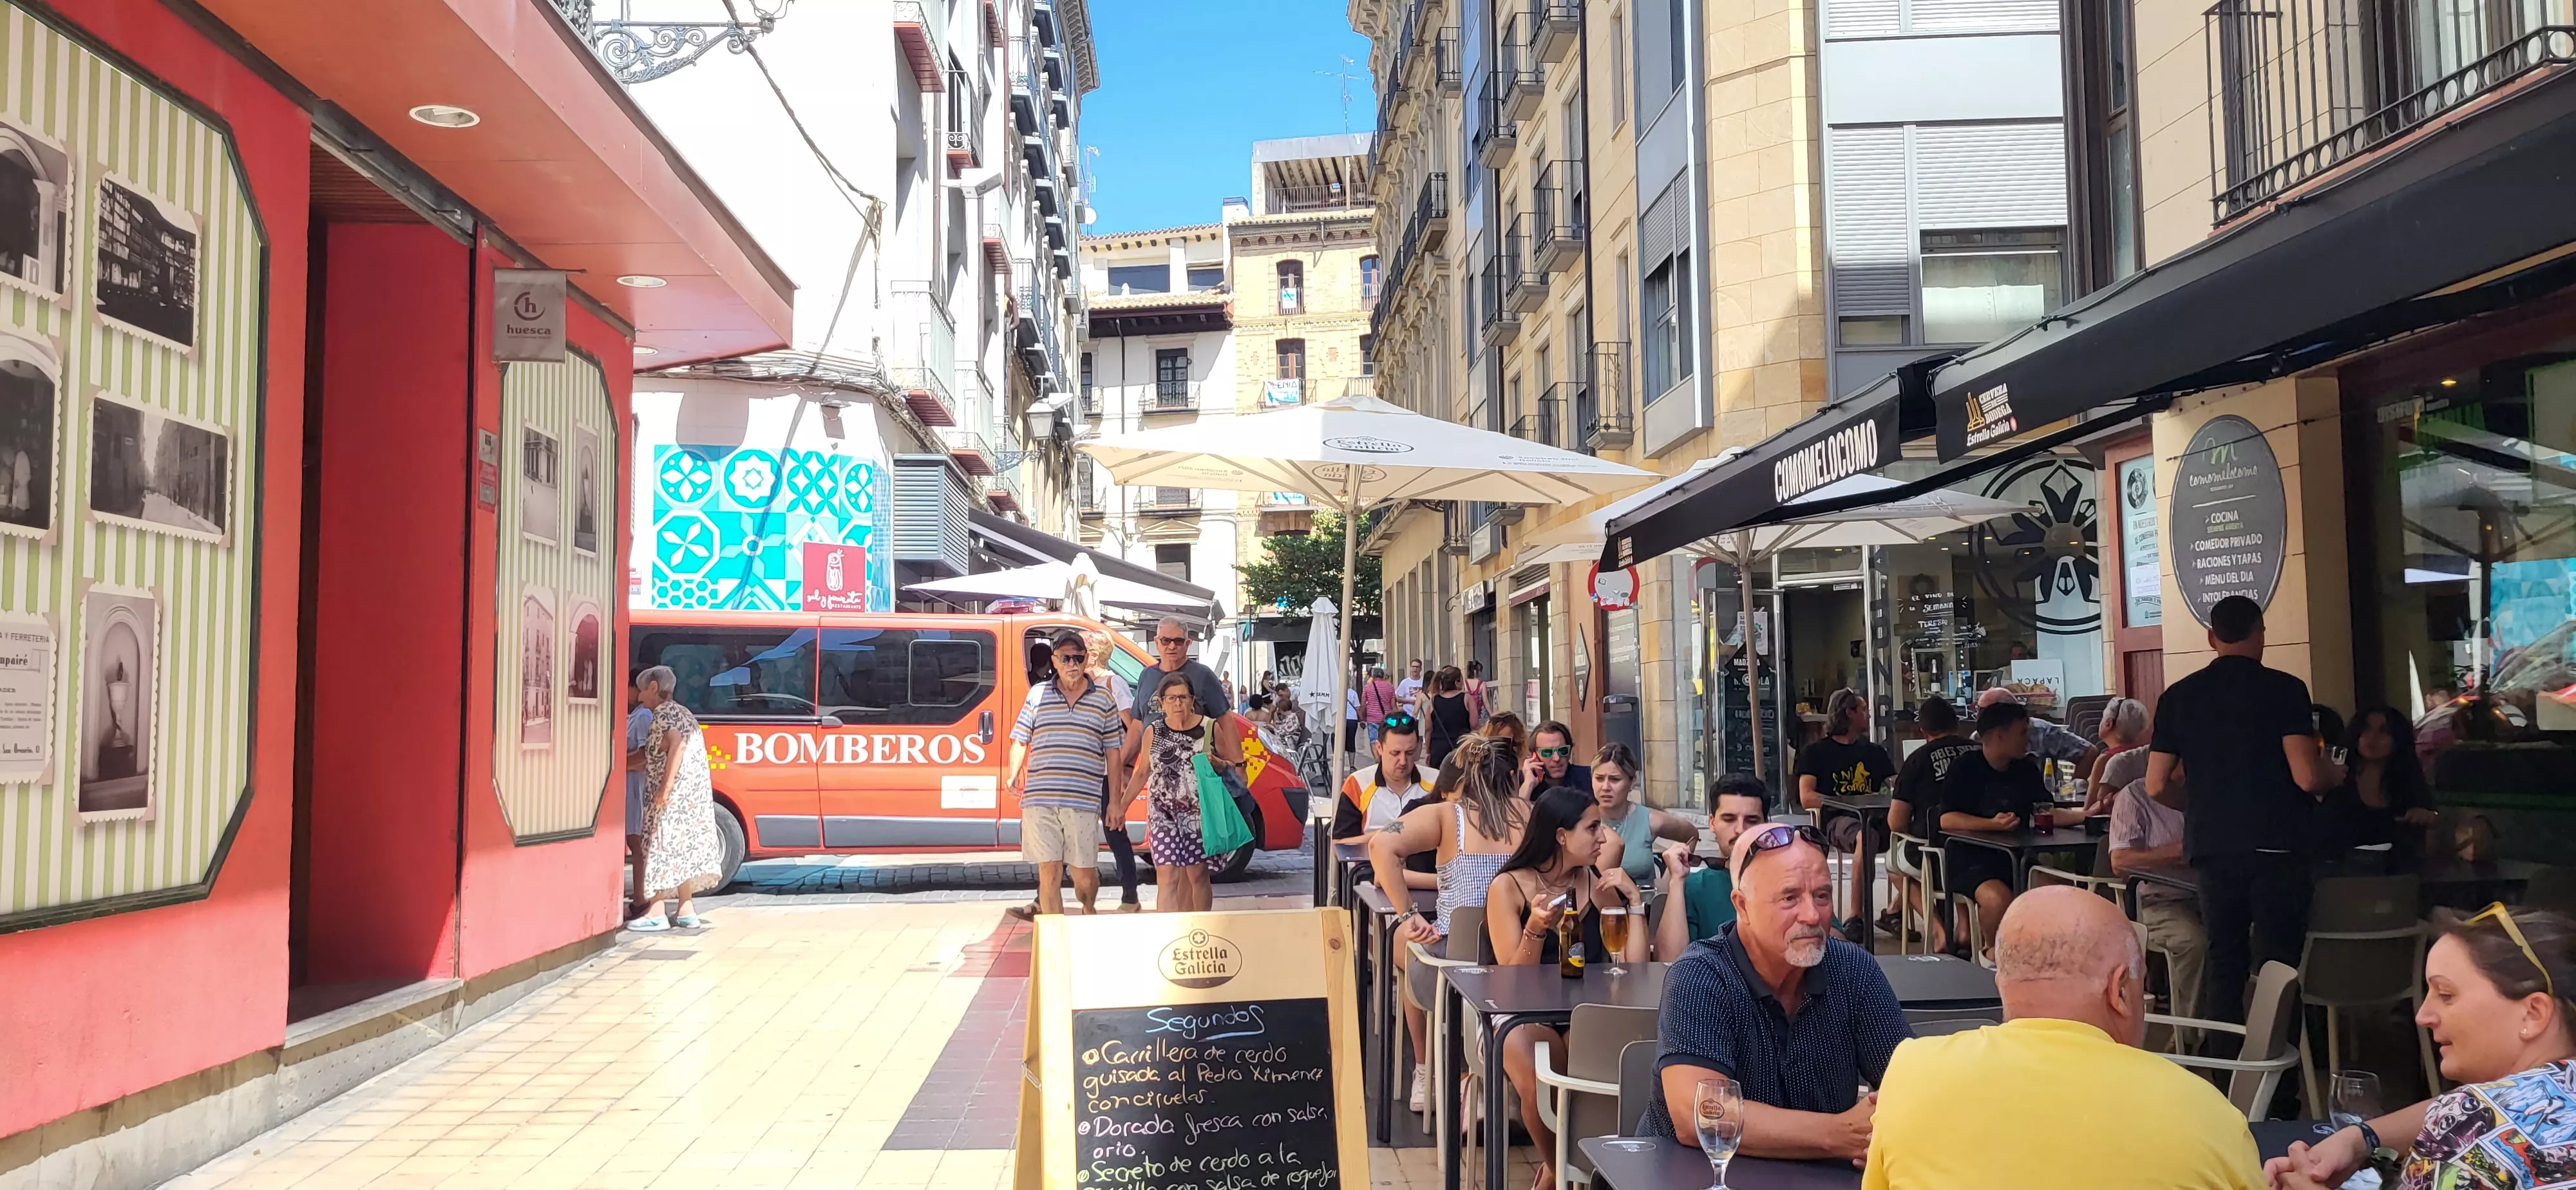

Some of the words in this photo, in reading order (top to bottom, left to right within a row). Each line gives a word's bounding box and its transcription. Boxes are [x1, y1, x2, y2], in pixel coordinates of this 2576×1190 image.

[507, 324, 551, 335] huesca
[1978, 382, 2008, 404] CERVEZA
[1984, 402, 2012, 424] BODEGA
[1967, 428, 1989, 447] Estrella
[1990, 419, 2010, 438] Galicia
[1775, 419, 1878, 502] COMOMELOCOMO
[2211, 509, 2239, 524] COCINA
[2195, 538, 2229, 552] COMEDOR
[2230, 533, 2262, 547] PRIVADO
[2197, 555, 2231, 569] RACIONES
[2231, 554, 2237, 565] Y
[2237, 552, 2262, 565] TAPAS
[2205, 574, 2226, 585] MENU
[2226, 572, 2239, 583] DEL
[2240, 571, 2255, 582] DIA
[1922, 602, 1954, 613] SEMANA
[11, 632, 50, 643] FERRETERIA
[734, 732, 986, 764] BOMBEROS
[1930, 746, 1956, 762] FIELES
[1173, 946, 1228, 961] Estrella
[1175, 960, 1226, 975] Galicia
[1145, 1005, 1265, 1040] Segundos
[1101, 1037, 1198, 1065] Carrillera
[1204, 1044, 1226, 1062] de
[1235, 1042, 1287, 1064] cerdo
[1083, 1066, 1161, 1099] guisada
[1168, 1064, 1186, 1082] al
[1197, 1062, 1242, 1083] Pedro
[1094, 1112, 1175, 1138] Dorada
[1185, 1112, 1244, 1145] fresca
[1252, 1112, 1282, 1127] con
[1092, 1155, 1165, 1182] Secreto
[1170, 1155, 1192, 1173] de
[1199, 1147, 1250, 1172] cerdo
[1258, 1153, 1274, 1164] a
[1279, 1142, 1302, 1165] la
[1260, 1170, 1280, 1187] de
